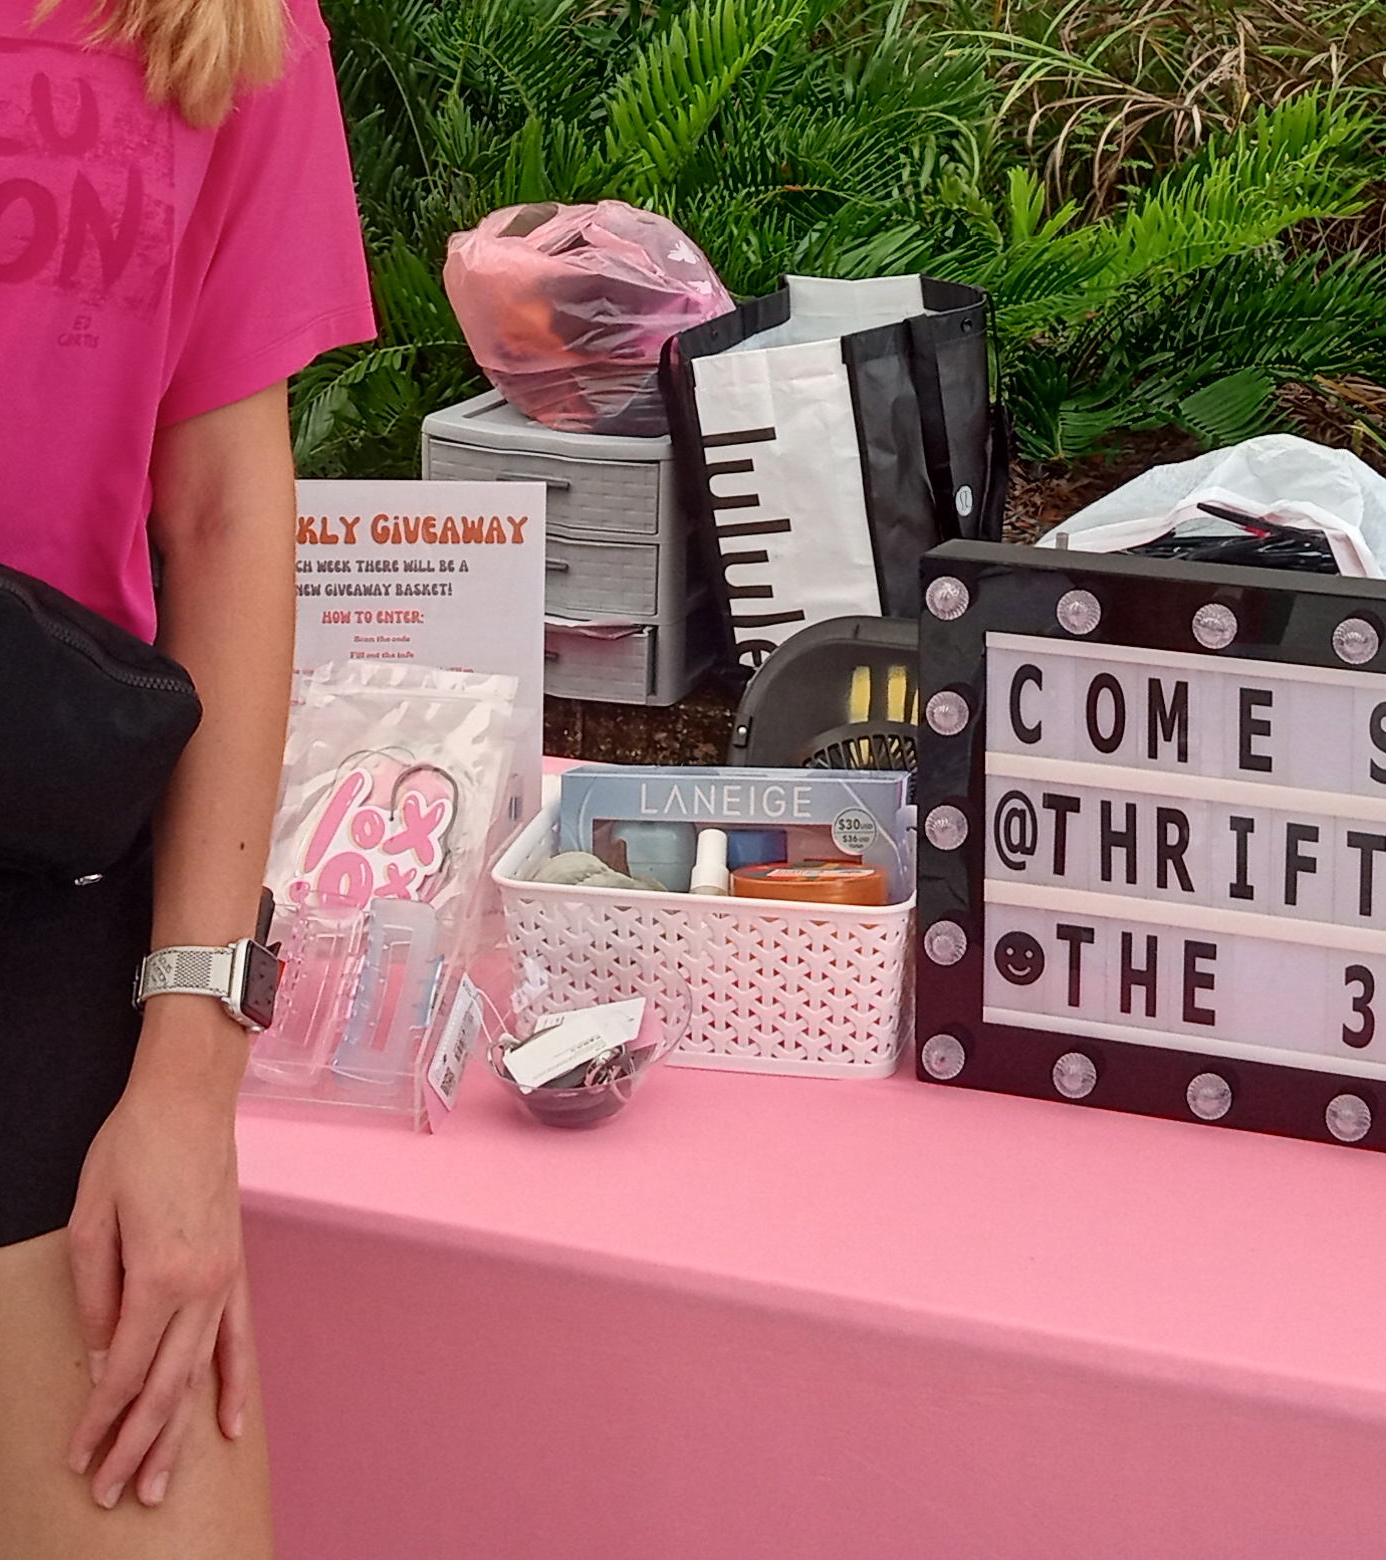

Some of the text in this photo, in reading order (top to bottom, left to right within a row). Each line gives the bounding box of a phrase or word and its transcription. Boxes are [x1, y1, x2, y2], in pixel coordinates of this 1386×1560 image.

[316, 560, 352, 574] WEEK
[355, 559, 400, 574] THERE
[439, 560, 455, 573] BE
[458, 560, 469, 573] A
[295, 584, 321, 597] NEW
[395, 583, 453, 597] BASKET!
[321, 610, 425, 624] HOW TO ENTER:
[376, 635, 391, 643] the
[391, 635, 411, 643] code
[381, 651, 396, 659] the
[396, 651, 415, 659] info
[1008, 663, 1275, 774] COME
[639, 782, 813, 819] LANEIGE
[838, 819, 861, 830] $30
[1056, 923, 1218, 1028] THE
